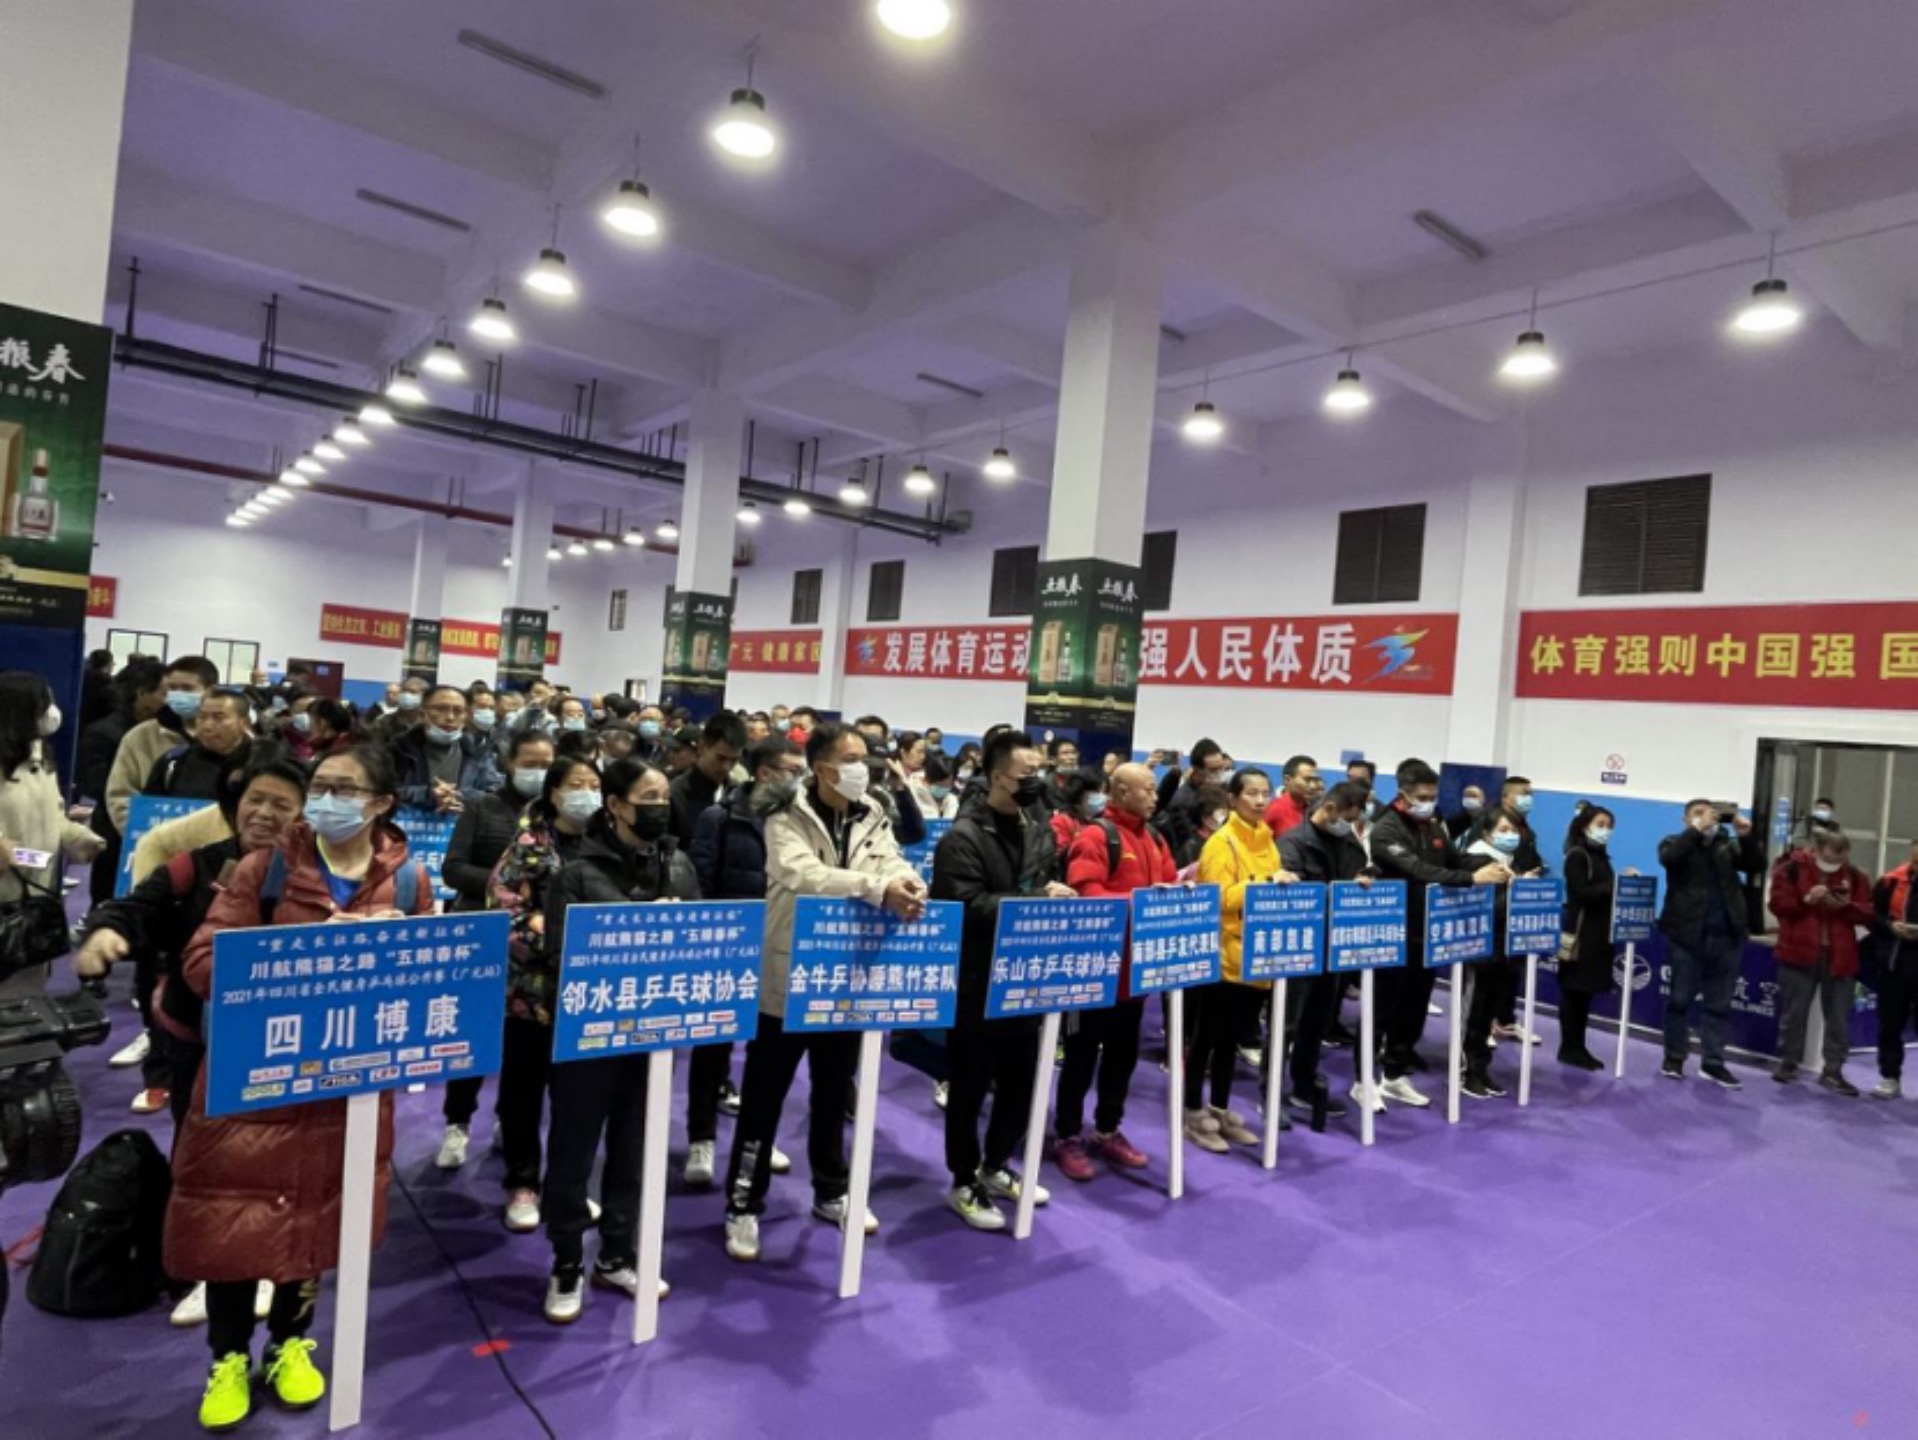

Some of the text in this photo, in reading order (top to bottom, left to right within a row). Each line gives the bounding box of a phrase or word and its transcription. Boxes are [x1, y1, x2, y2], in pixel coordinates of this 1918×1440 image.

[884, 622, 1356, 684] 发展体育运动 强人民体质
[562, 968, 759, 1016] 邻水县乒乓球协会
[993, 950, 1122, 984] 乐山市乒乓球协会
[265, 994, 460, 1058] 四川博康
